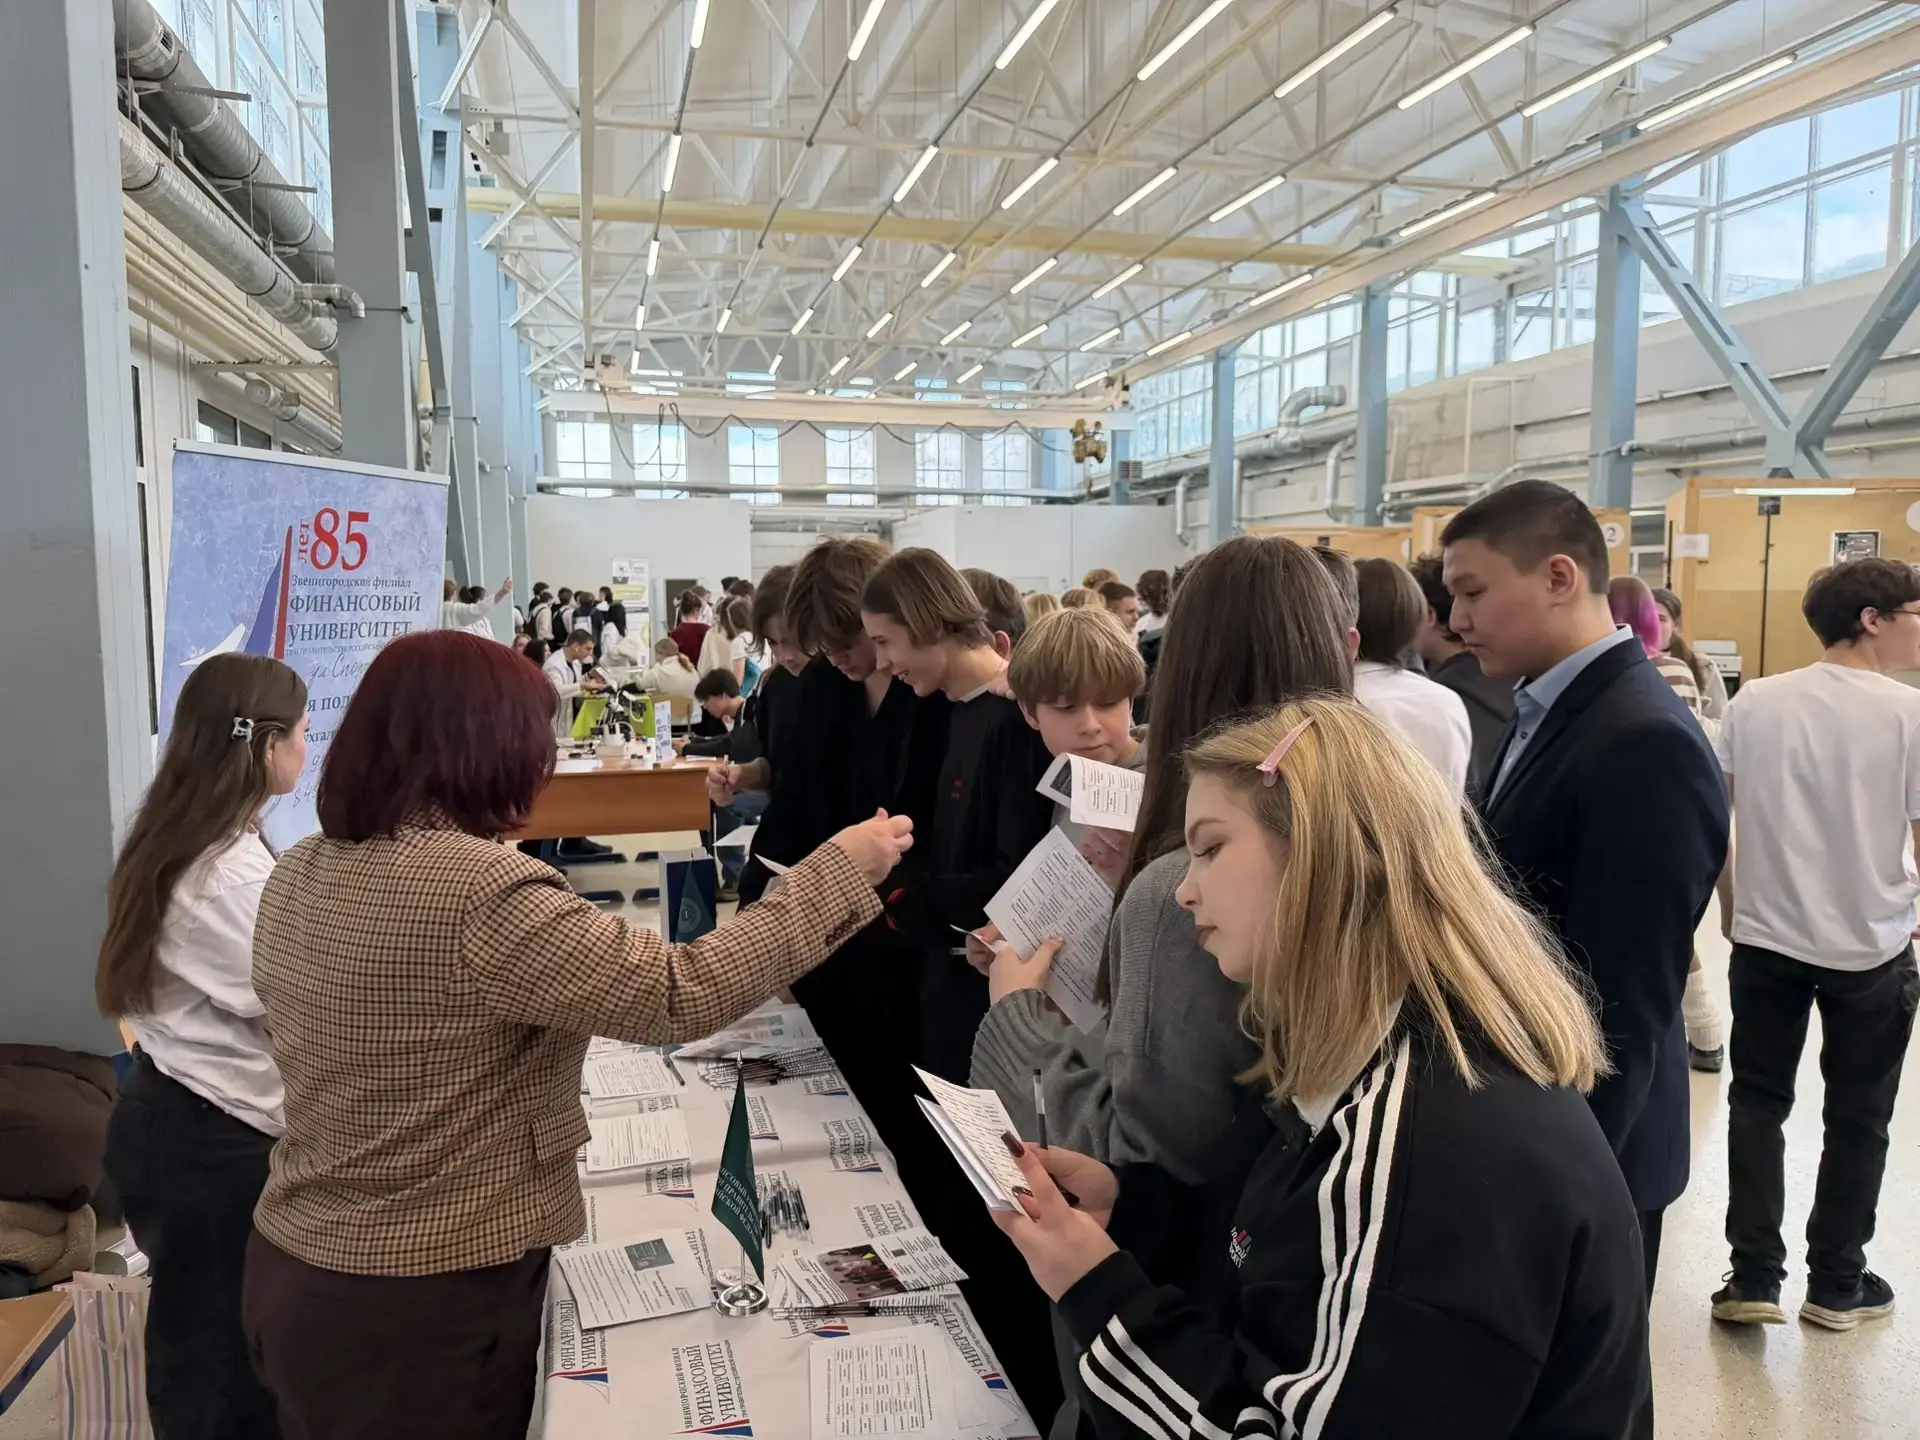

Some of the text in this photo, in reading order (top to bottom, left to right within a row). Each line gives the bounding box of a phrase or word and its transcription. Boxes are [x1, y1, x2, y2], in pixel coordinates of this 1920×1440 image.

[297, 518, 309, 564] лет
[310, 507, 370, 572] 85
[1606, 527, 1616, 543] 2
[291, 575, 411, 590] Звенигородский филиал
[290, 592, 421, 613] ФИНАНСОВЫЙ
[288, 621, 412, 647] УНИВЕРСИТЕТ
[555, 1299, 576, 1370] ФИНАНСОВЫЙ
